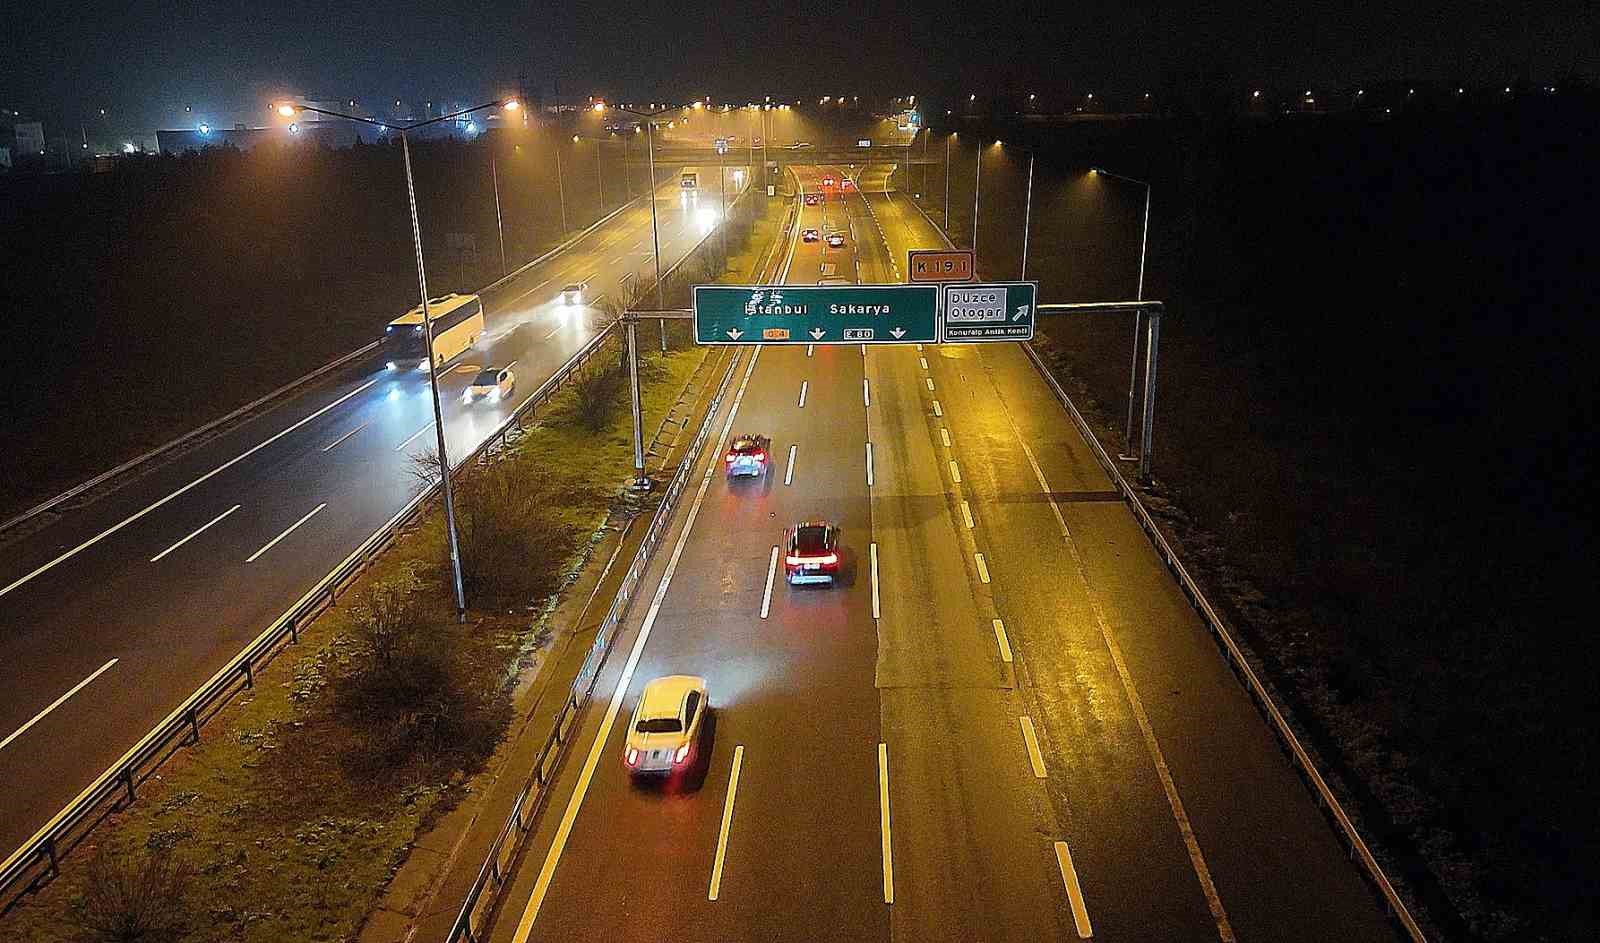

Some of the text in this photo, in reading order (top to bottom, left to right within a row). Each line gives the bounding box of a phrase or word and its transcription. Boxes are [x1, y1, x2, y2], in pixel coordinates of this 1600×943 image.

[917, 261, 927, 273] K
[951, 293, 996, 304] Düzce
[830, 304, 890, 315] Sakarya
[951, 308, 1001, 320] Otogar
